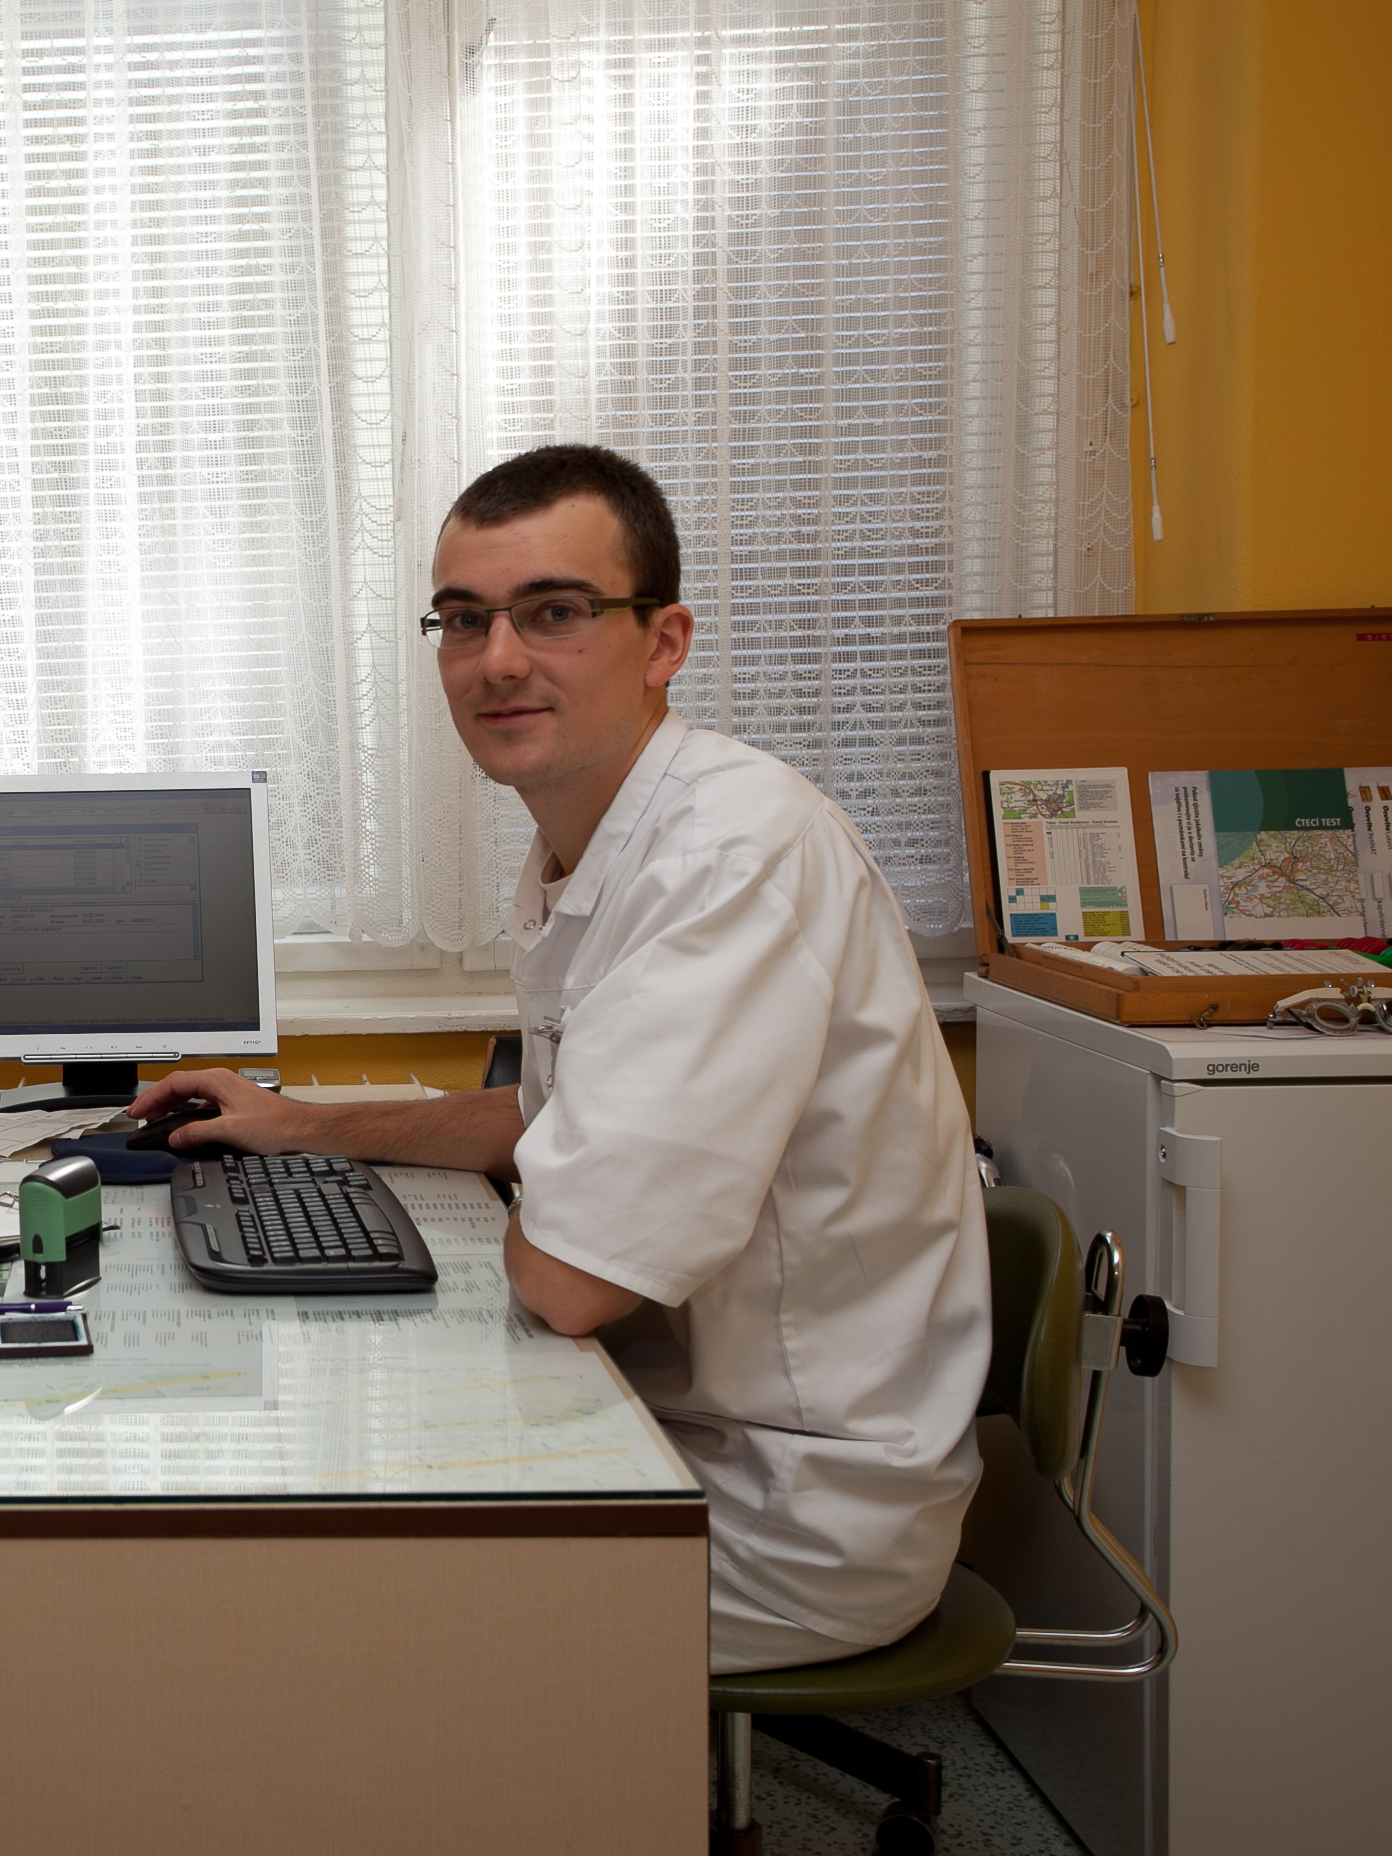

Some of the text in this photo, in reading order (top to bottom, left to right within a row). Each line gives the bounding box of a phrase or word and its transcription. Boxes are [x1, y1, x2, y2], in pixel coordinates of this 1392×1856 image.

[1174, 793, 1182, 812] nejdříve
[1182, 786, 1192, 820] poznamenejte
[1188, 836, 1196, 856] dostavte
[1295, 816, 1341, 828] ČTECÍ TEST
[1364, 805, 1372, 832] Ocuvite
[1176, 819, 1186, 850] poznámkami
[1206, 1060, 1260, 1076] gorenje
